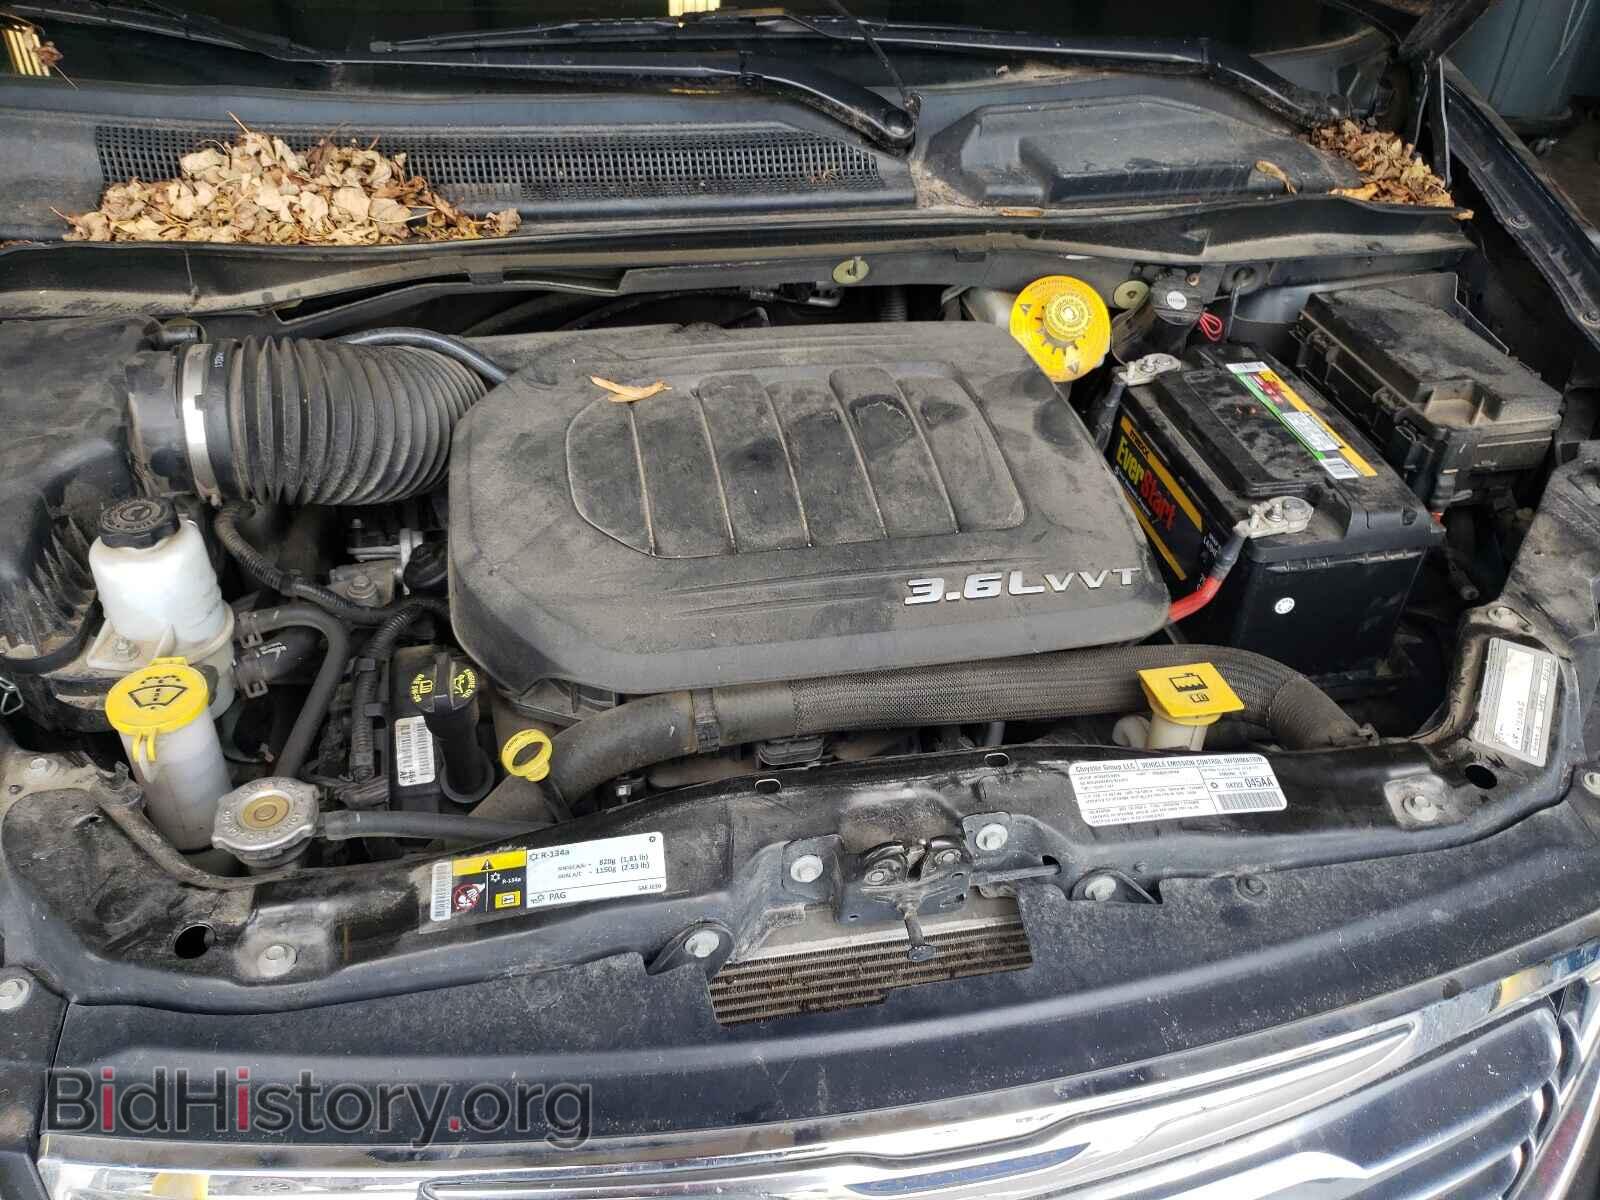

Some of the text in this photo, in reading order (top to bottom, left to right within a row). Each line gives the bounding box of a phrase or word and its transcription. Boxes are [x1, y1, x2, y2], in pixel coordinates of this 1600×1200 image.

[1116, 435, 1177, 531] EverStart
[1102, 764, 1122, 773] Group
[1141, 756, 1263, 769] VEHICLE EMISSION CONTROL INFORMATION
[541, 848, 570, 860] R-134a
[549, 891, 567, 900] PAG
